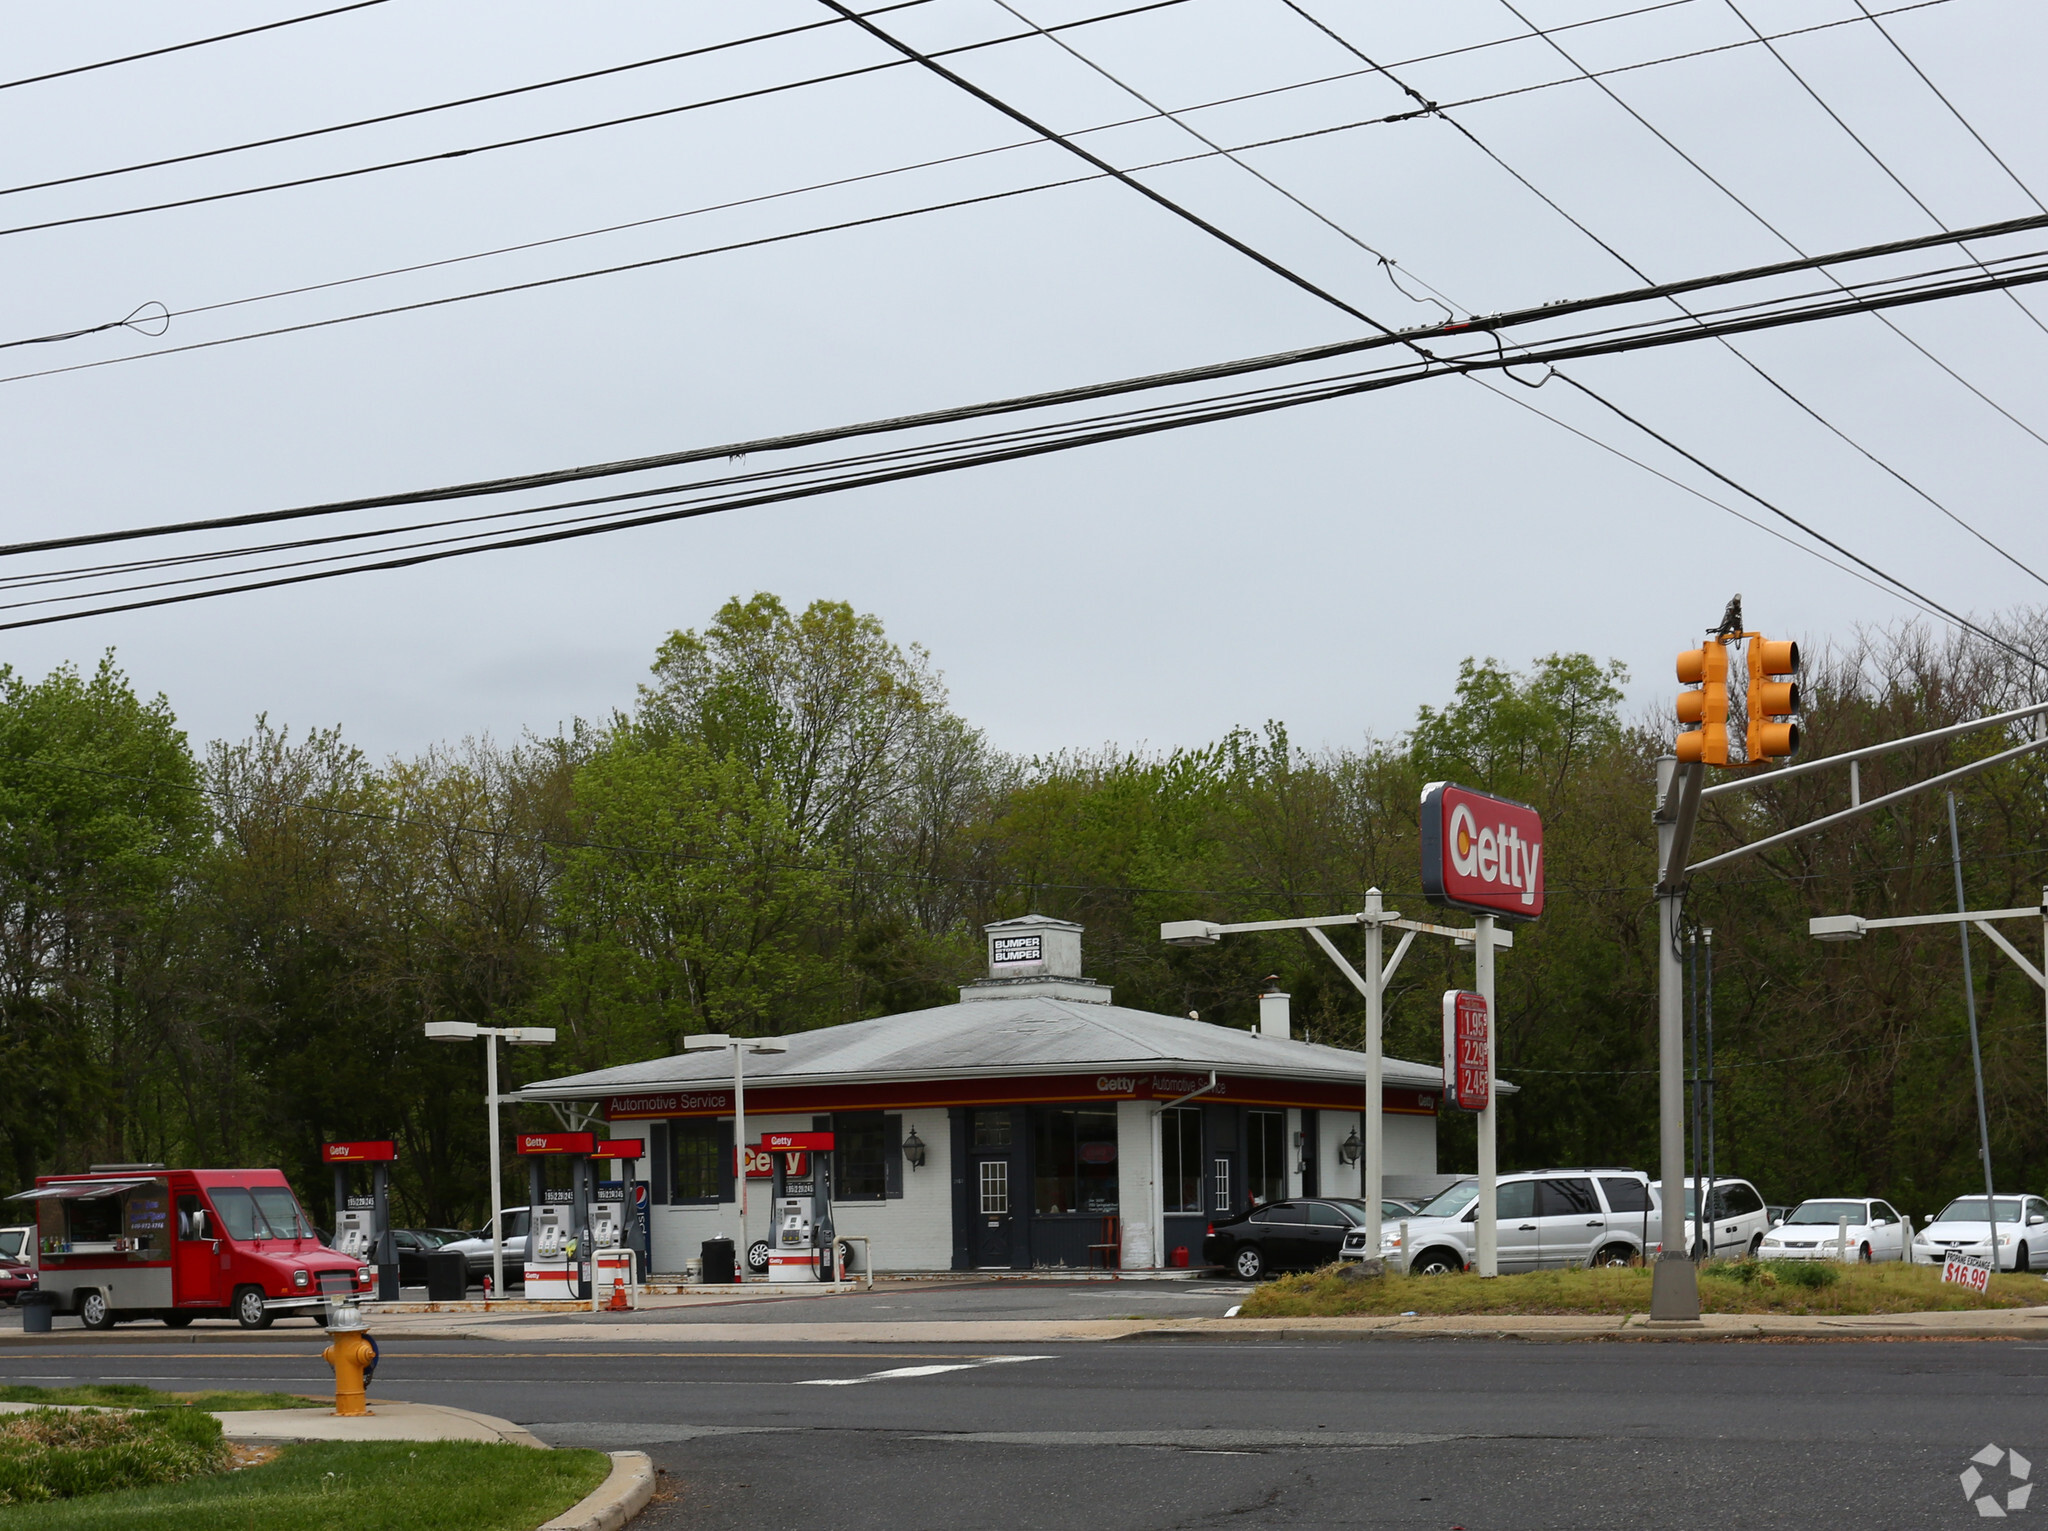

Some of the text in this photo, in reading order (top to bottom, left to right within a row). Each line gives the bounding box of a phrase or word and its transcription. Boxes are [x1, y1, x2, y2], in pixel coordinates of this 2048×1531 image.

[1450, 803, 1541, 906] Getty
[994, 937, 1040, 949] BUMPER
[994, 950, 1041, 962] BUMPER
[1097, 1076, 1136, 1093] Getty
[1152, 1075, 1196, 1092] Automotive
[610, 1093, 726, 1111] Automotive Service
[525, 1137, 547, 1148] Getty
[771, 1136, 792, 1147] Getty
[329, 1145, 350, 1156] Getty
[744, 1147, 801, 1175] Gey
[1947, 1252, 1991, 1270] PROPANE EXCHANGE
[1945, 1262, 1986, 1290] $16.99
